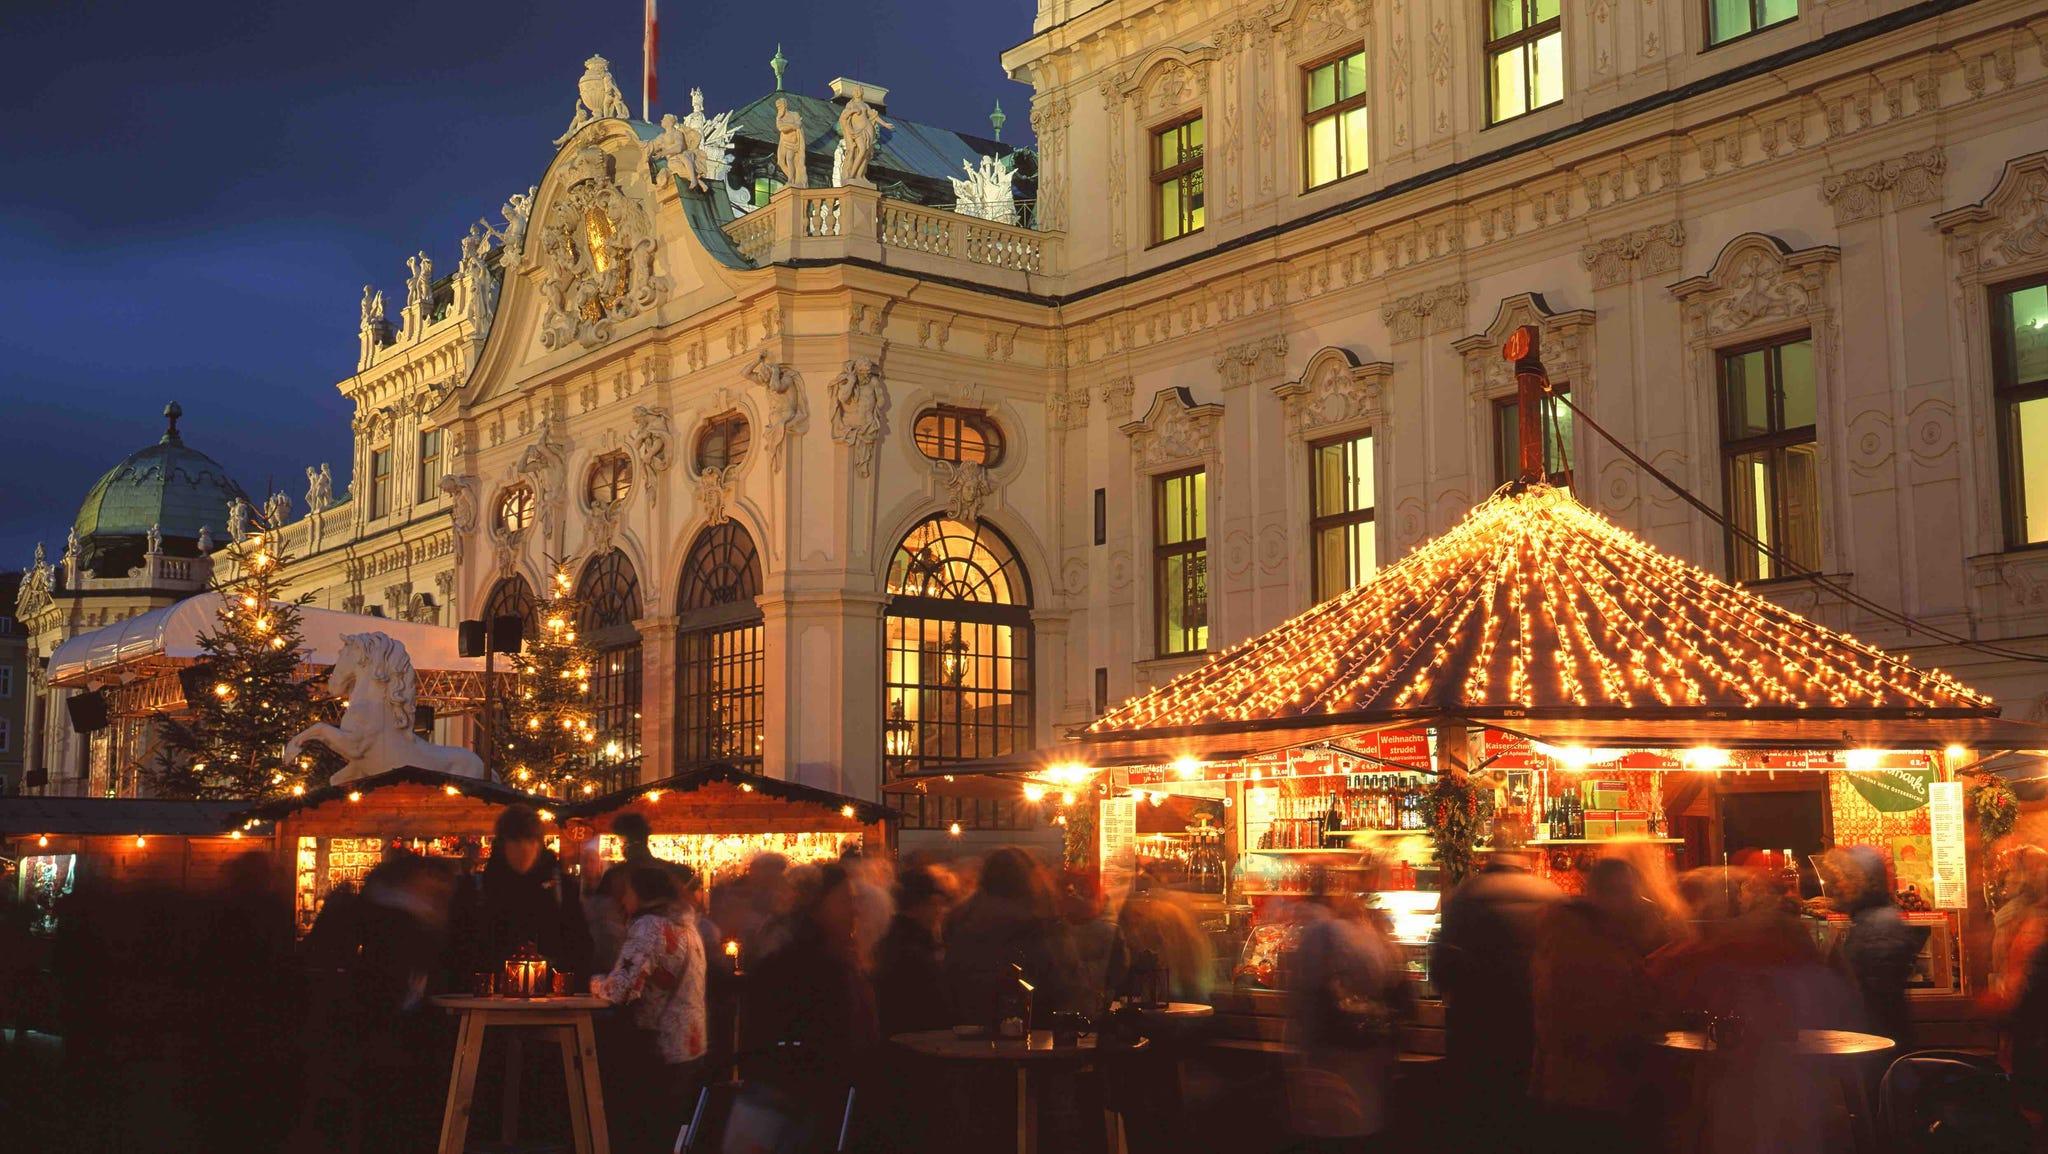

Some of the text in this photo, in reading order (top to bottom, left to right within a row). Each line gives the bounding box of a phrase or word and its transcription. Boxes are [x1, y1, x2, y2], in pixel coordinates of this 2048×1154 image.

[1380, 735, 1425, 744] Weihnachts
[1389, 745, 1417, 755] strudel
[571, 826, 586, 840] 13
